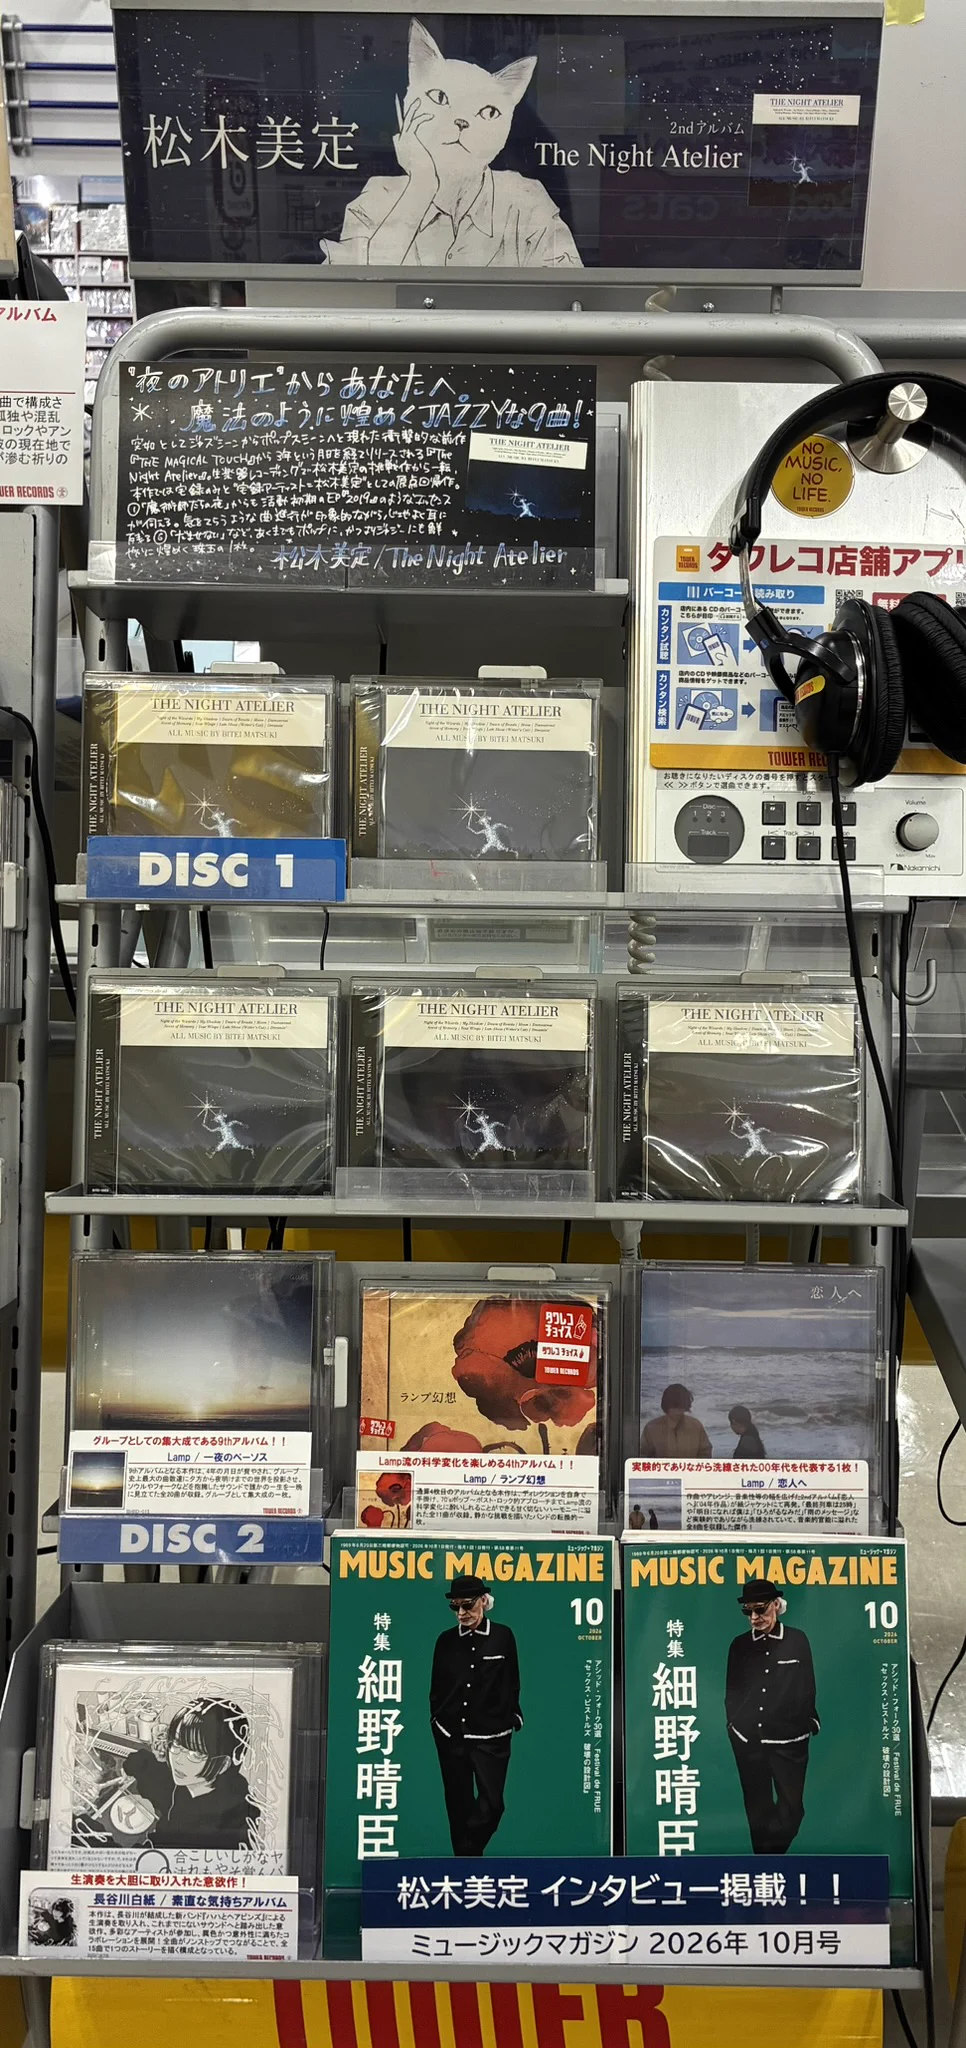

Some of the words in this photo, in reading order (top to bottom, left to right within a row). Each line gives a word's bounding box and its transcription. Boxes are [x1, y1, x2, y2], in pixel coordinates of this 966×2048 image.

[787, 98, 812, 106] NIGHT
[813, 99, 844, 107] ATELIER
[669, 121, 745, 136] 2ndアルバム
[142, 114, 360, 170] 松木美定
[534, 142, 580, 167] The
[588, 143, 654, 173] Night
[660, 144, 743, 170] Atelier
[2, 424, 72, 438] ロックやアン
[489, 437, 507, 446] THE
[508, 439, 536, 449] NIGHT
[536, 442, 570, 452] ATELIER
[802, 442, 825, 454] NO
[785, 456, 843, 473] MUSIC,
[801, 473, 824, 485] NO
[17, 486, 55, 498] RECORDS
[792, 487, 832, 503] LIFE.
[493, 540, 568, 569] Atelier
[151, 698, 180, 710] THE
[185, 699, 232, 711] NIGHT
[235, 700, 295, 713] ATELIER
[418, 703, 449, 715] THE
[452, 704, 499, 716] NIGHT
[503, 705, 562, 717] ATELIER
[244, 731, 277, 739] MATSUKI
[511, 735, 545, 743] MATSUKI
[89, 743, 98, 781] ATELIER
[768, 751, 805, 766] TOWER
[89, 783, 98, 812] NIGHT
[89, 815, 98, 834] THE
[138, 852, 249, 888] DISC
[275, 854, 294, 888] 1
[903, 864, 941, 872] Nakamichi
[154, 1001, 184, 1013] THE
[189, 1002, 236, 1014] NIGHT
[238, 1003, 298, 1015] ATELIER
[417, 1003, 448, 1014] THE
[450, 1004, 497, 1016] NIGHT
[501, 1005, 559, 1017] ATELIER
[681, 1008, 711, 1019] THE
[715, 1009, 762, 1021] NIGHT
[765, 1010, 824, 1022] ATELIER
[247, 1033, 280, 1041] MATSUKI
[450, 1034, 474, 1042] MUSIC
[509, 1035, 542, 1043] MATSUKI
[774, 1040, 807, 1048] MATSUKI
[94, 1048, 103, 1086] ATELIER
[356, 1046, 366, 1084] ATELIER
[94, 1088, 103, 1117] NIGHT
[356, 1086, 366, 1114] NIGHT
[94, 1120, 103, 1139] THE
[356, 1117, 366, 1136] THE
[810, 1285, 862, 1300] 恋人へ
[545, 1311, 574, 1326] タワレコ
[545, 1325, 573, 1339] チョイス
[400, 1392, 457, 1403] ランプ幻想
[167, 1452, 191, 1463] Lamp
[204, 1452, 268, 1462] 一夜のペーソス
[463, 1474, 487, 1485] Lamp
[500, 1474, 546, 1486] ランプ幻想
[741, 1478, 765, 1488] Lamp
[778, 1478, 807, 1488] 恋人へ
[120, 1523, 217, 1554] DISC
[235, 1523, 265, 1554] 2
[340, 1550, 434, 1580] MUSIC
[445, 1552, 604, 1582] MAGAZINE
[630, 1555, 725, 1587] MUSIC
[736, 1555, 898, 1586] MAGAZINE
[570, 1597, 604, 1626] 10
[864, 1600, 898, 1629] 10
[373, 1612, 391, 1651] 特集
[666, 1619, 684, 1658] 特集
[355, 1654, 405, 1860] 細野晴臣
[652, 1662, 700, 1857] 細野晴臣
[594, 1791, 602, 1813] FRUE
[894, 1794, 902, 1816] FRUE
[93, 1893, 156, 1906] 長谷川白紙
[172, 1894, 287, 1908] 素直な気持ちアルバム
[397, 1875, 530, 1910] 松木美定
[410, 1931, 638, 1957] ミュージックマガジン
[650, 1930, 749, 1956] 2026年
[758, 1930, 841, 1955] 10月号
